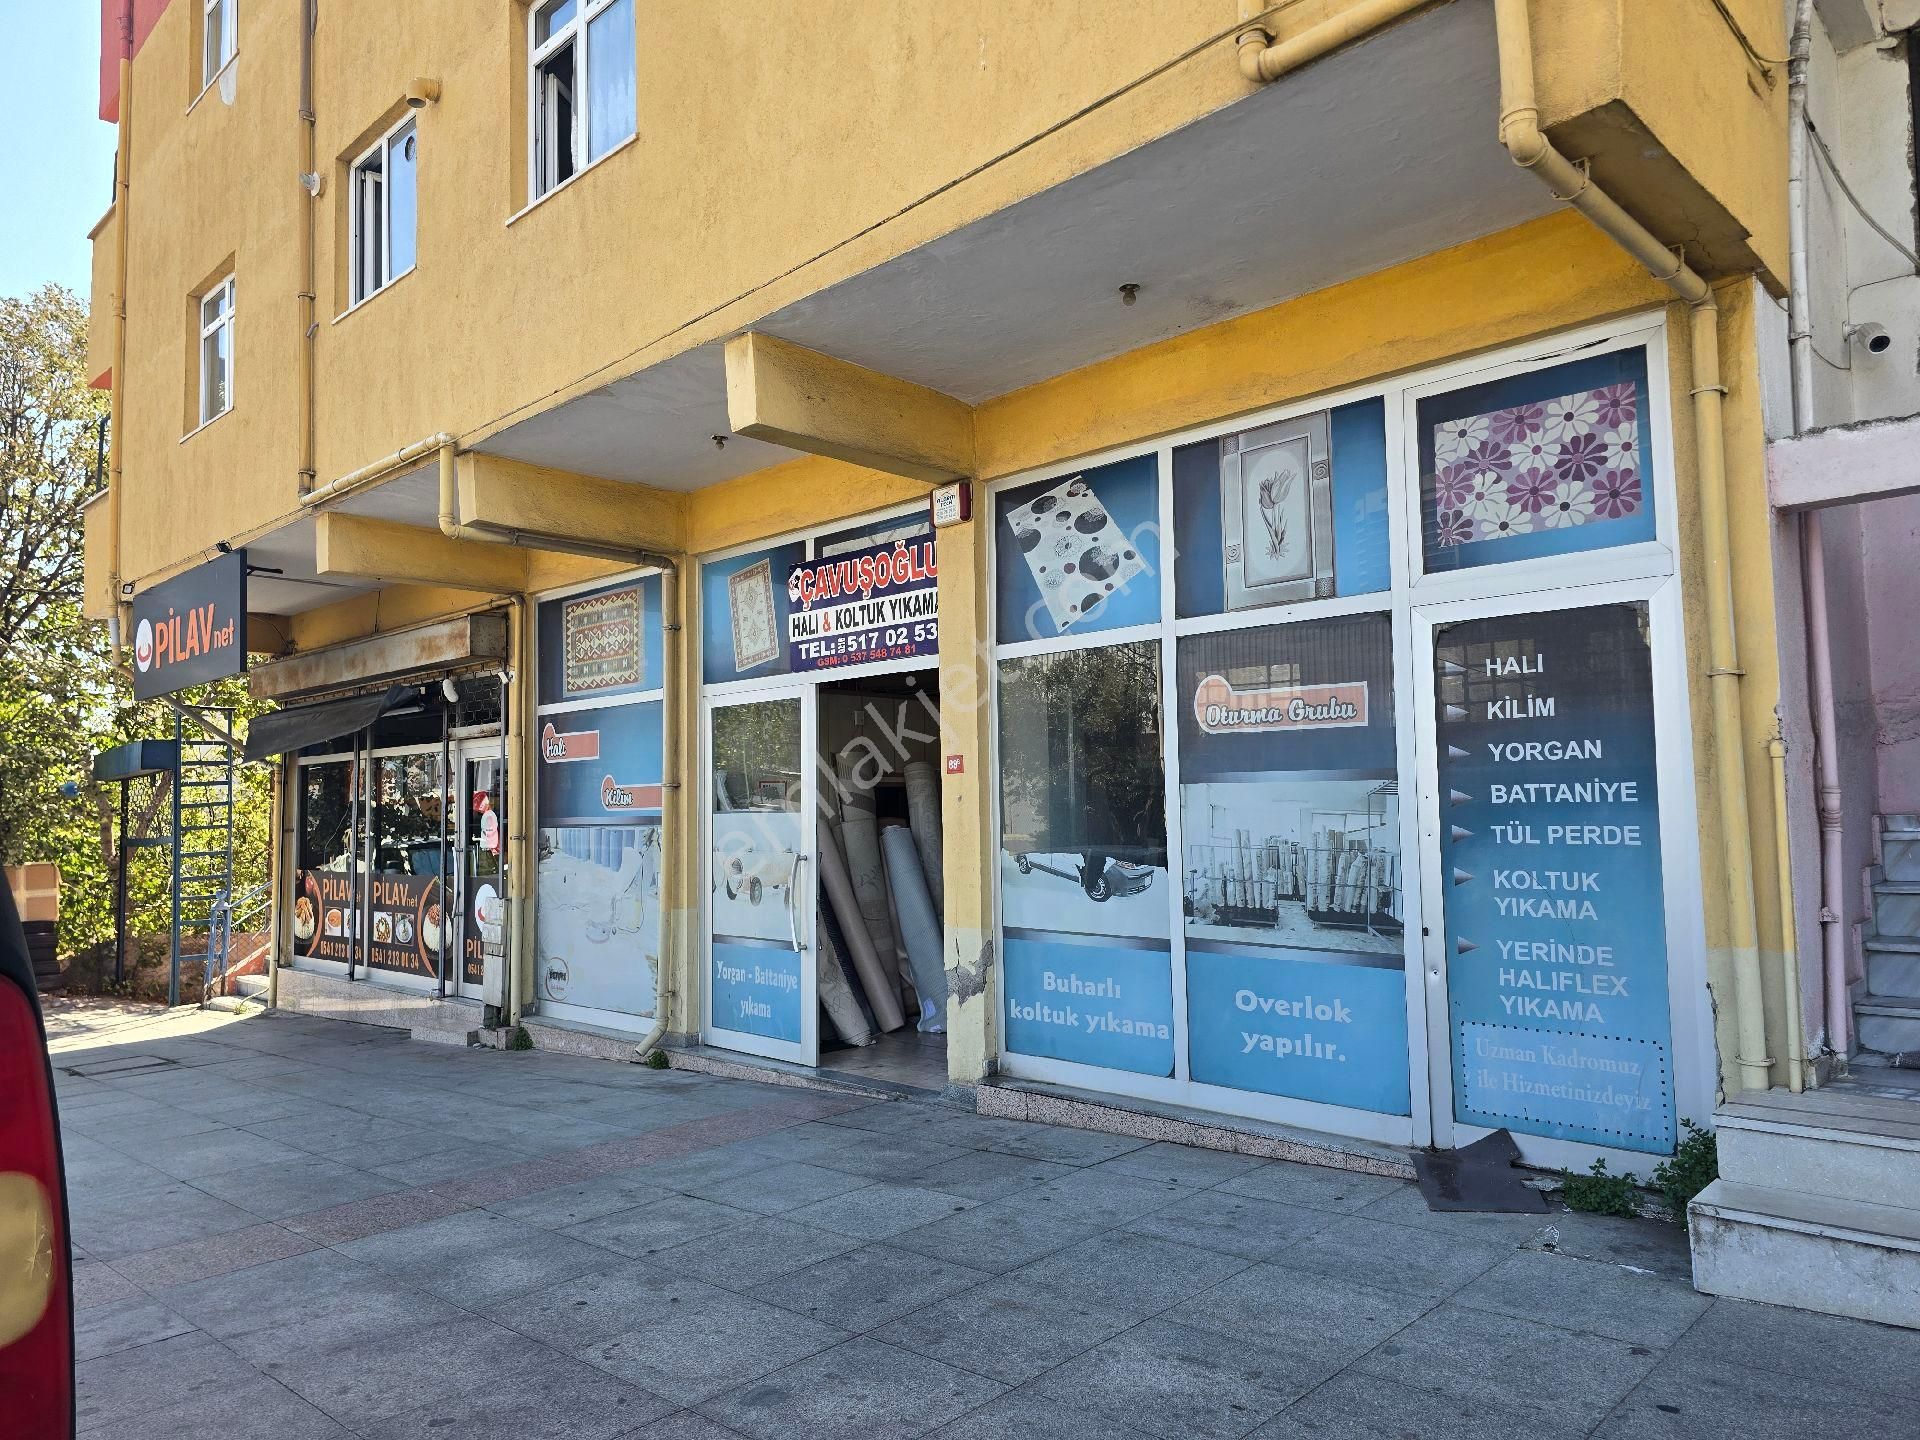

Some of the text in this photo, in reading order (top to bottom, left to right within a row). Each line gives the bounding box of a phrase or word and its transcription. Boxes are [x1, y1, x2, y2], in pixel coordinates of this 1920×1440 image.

[799, 540, 938, 611] ÇAVUŞOĞLU
[792, 613, 818, 638] HALI
[822, 611, 832, 633] &
[835, 600, 886, 631] KOLTUK
[798, 640, 836, 660] TEL:
[847, 632, 879, 652] 517
[885, 626, 909, 647] 02
[914, 622, 938, 642] 53
[817, 655, 841, 667] GSM:
[850, 651, 867, 662] 537
[869, 648, 887, 660] 548
[889, 646, 902, 657] 74
[904, 643, 916, 655] 81
[1485, 653, 1544, 677] HALI
[1205, 696, 1358, 727] Oturma Grubu
[1487, 694, 1555, 720] KİLİM
[1487, 739, 1603, 762] YORGAN
[605, 787, 633, 806] Kilim
[1490, 777, 1639, 804] BATTANİYE
[1490, 820, 1642, 846] TÜL PERDE
[1493, 869, 1601, 892] KOLTUK
[1494, 897, 1599, 921] YIKAMA
[466, 935, 483, 960] PİL
[1496, 938, 1615, 967] YERİNDE
[716, 960, 746, 985] Yorgan
[754, 965, 798, 993] Battaniye
[1042, 970, 1122, 999] Buharlı
[1499, 968, 1629, 997] HALIFLEX
[740, 995, 772, 1019] yıkama
[1009, 998, 1170, 1041] koltuk yıkama
[1235, 989, 1353, 1025] Overlok
[1500, 995, 1605, 1023] YIKAMA
[1240, 1029, 1347, 1063] yapılır.
[1476, 1037, 1641, 1076] Uzman Kadromuz
[1477, 1068, 1652, 1114] ile Hizmetinizdeyiz
